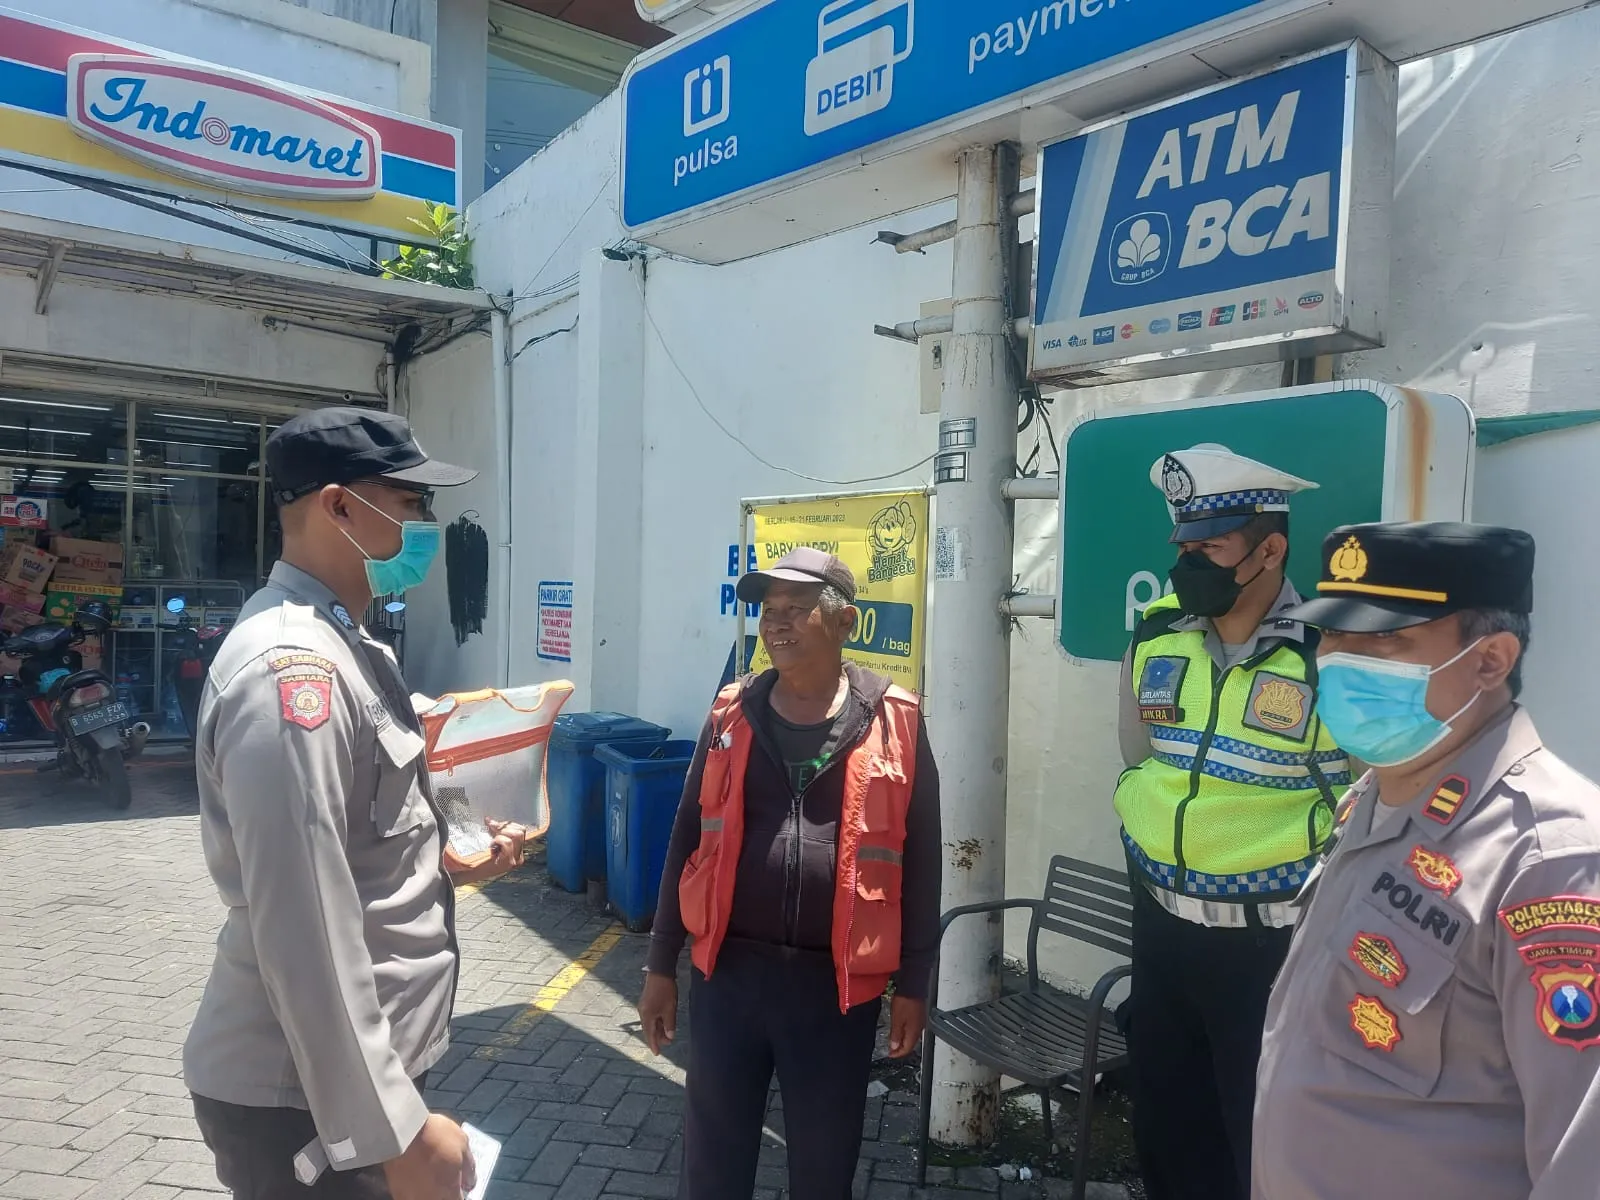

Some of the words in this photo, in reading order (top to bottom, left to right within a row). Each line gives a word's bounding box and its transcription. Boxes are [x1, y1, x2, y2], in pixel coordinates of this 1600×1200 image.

[816, 62, 888, 116] DEBIT
[89, 76, 365, 178] Indomaret
[1136, 89, 1301, 200] ATM
[673, 133, 739, 187] pulsa
[1177, 171, 1331, 270] BCA
[1141, 267, 1156, 279] BCA
[1042, 338, 1062, 350] VISA
[1299, 295, 1323, 305] ALTO
[872, 548, 907, 570] Hemat
[889, 637, 911, 655] bag
[1371, 871, 1461, 946] POLRI
[1505, 901, 1600, 929] POLRESTABES
[1514, 914, 1599, 934] SURABAYA
[1529, 947, 1557, 958] JAWA
[1559, 946, 1594, 957] TIMUR
